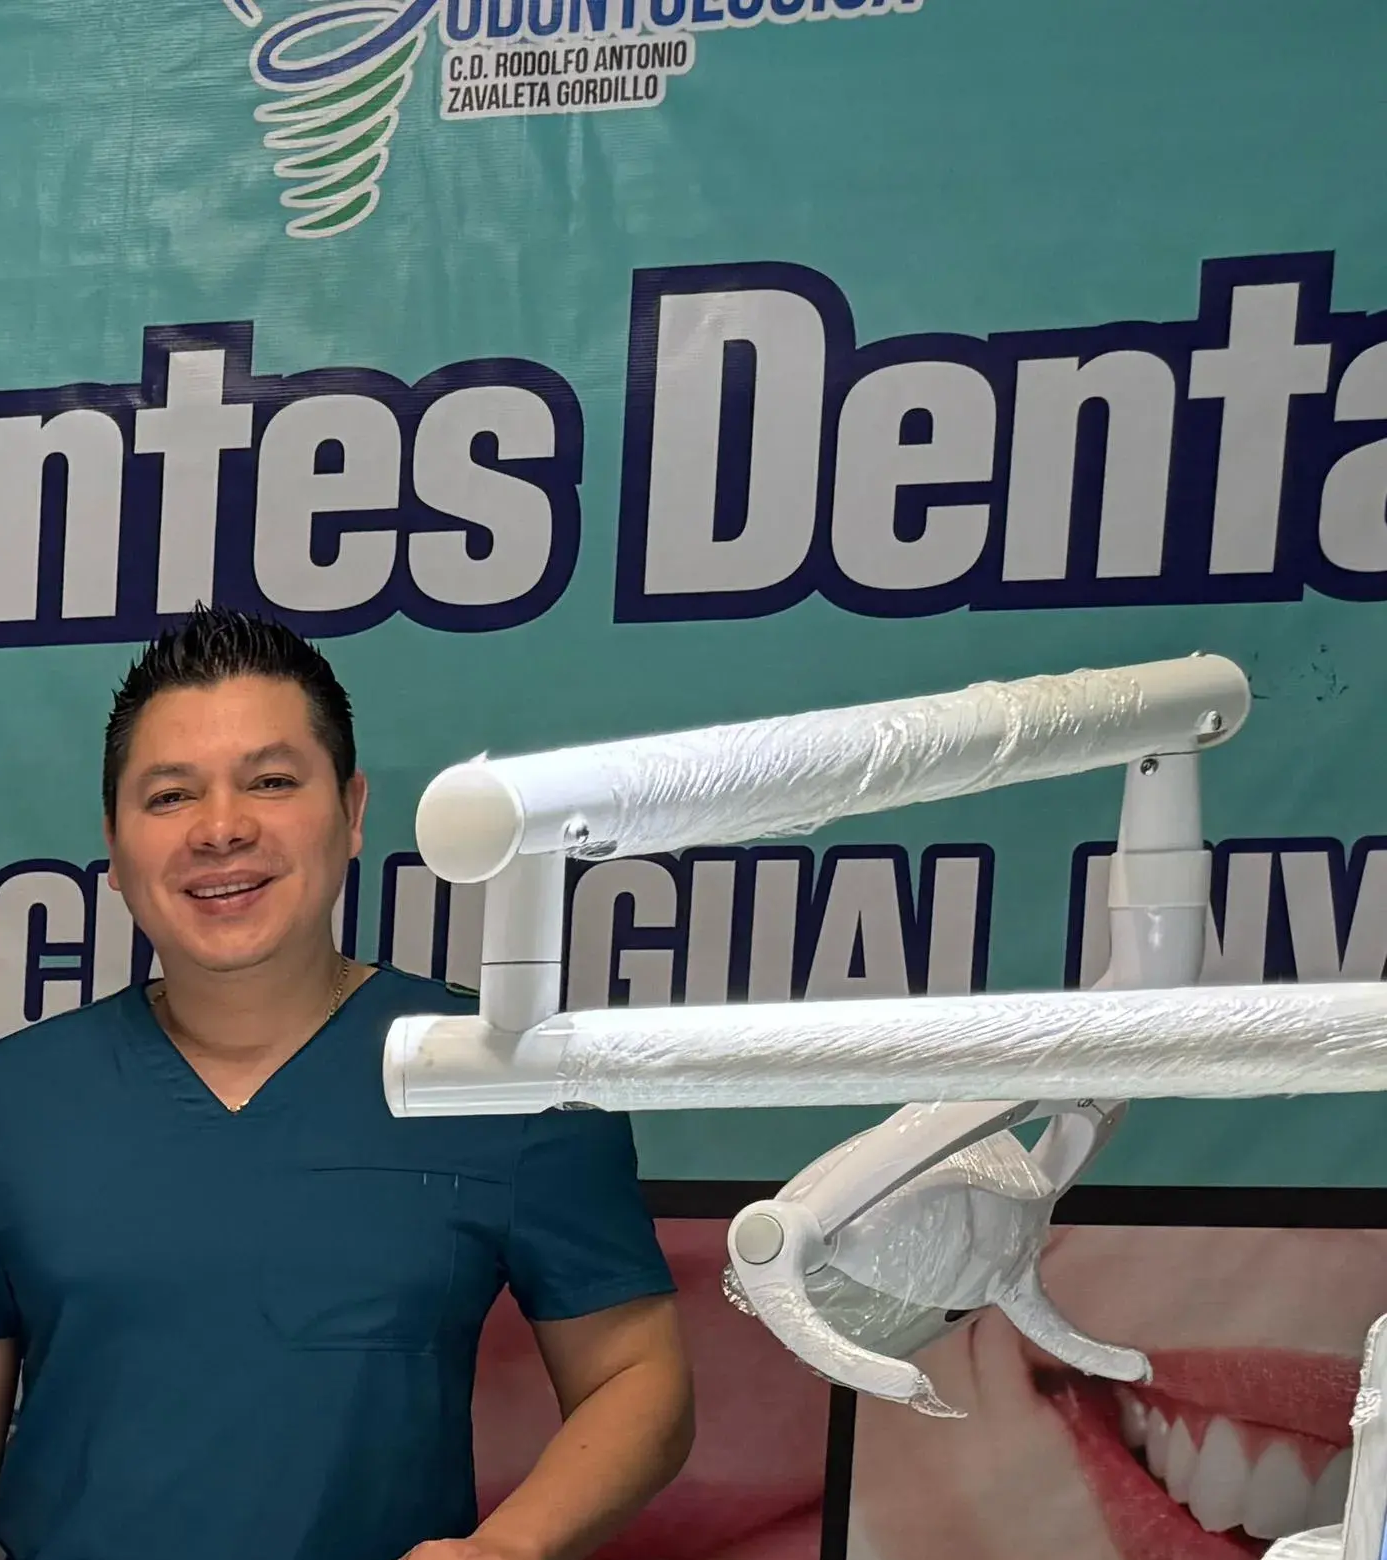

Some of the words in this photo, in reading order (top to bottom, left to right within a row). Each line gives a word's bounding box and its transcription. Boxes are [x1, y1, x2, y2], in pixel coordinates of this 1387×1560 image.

[449, 55, 489, 82] C.D.
[495, 47, 589, 78] RODOLFO
[594, 39, 688, 71] ANTONIO
[447, 80, 553, 113] ZAVALETA
[556, 74, 660, 106] GORDILLO
